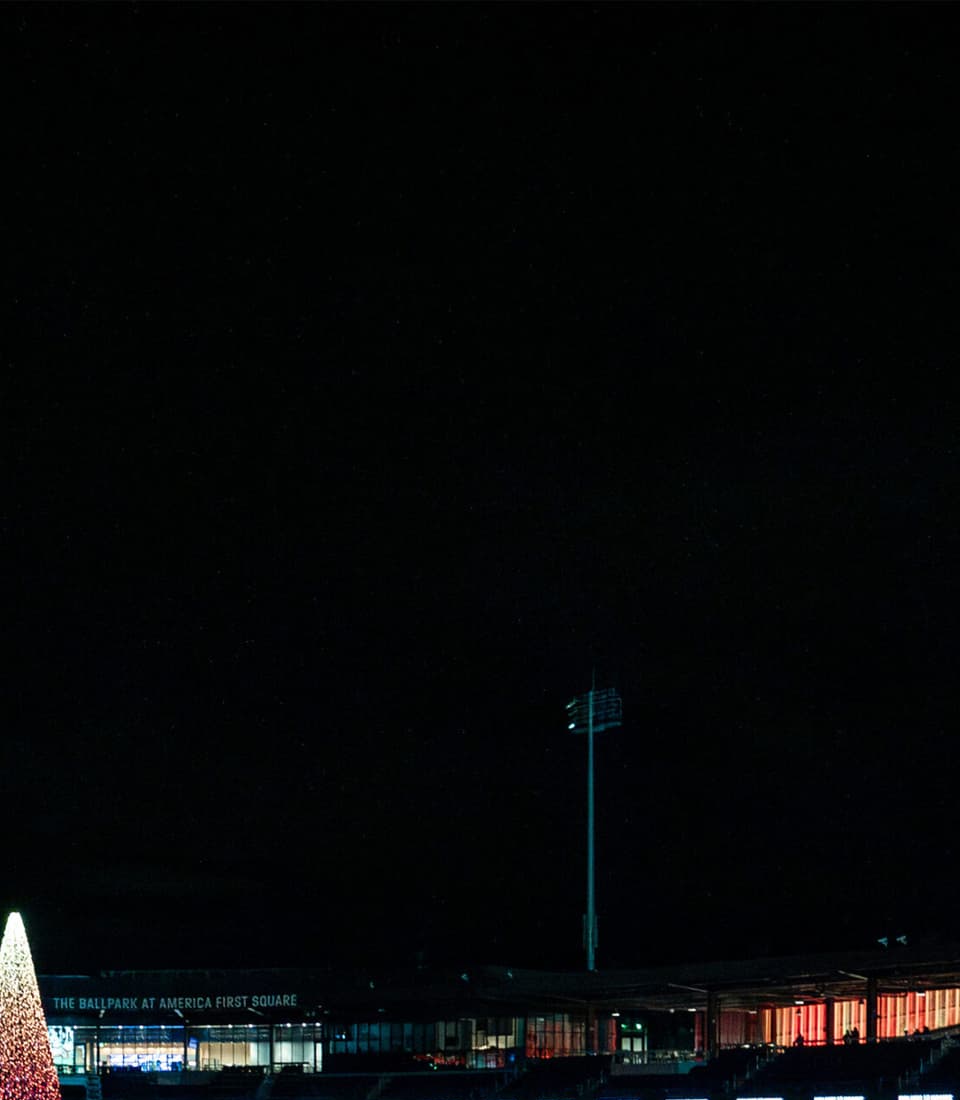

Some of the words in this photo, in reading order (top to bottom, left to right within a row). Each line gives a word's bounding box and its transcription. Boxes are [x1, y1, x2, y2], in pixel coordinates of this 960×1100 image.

[53, 997, 75, 1009] THE
[79, 997, 138, 1009] BALLPARK
[141, 997, 156, 1009] AT
[159, 996, 212, 1009] AMERICA
[215, 996, 249, 1008] FIRST
[251, 994, 297, 1007] SQUARE
